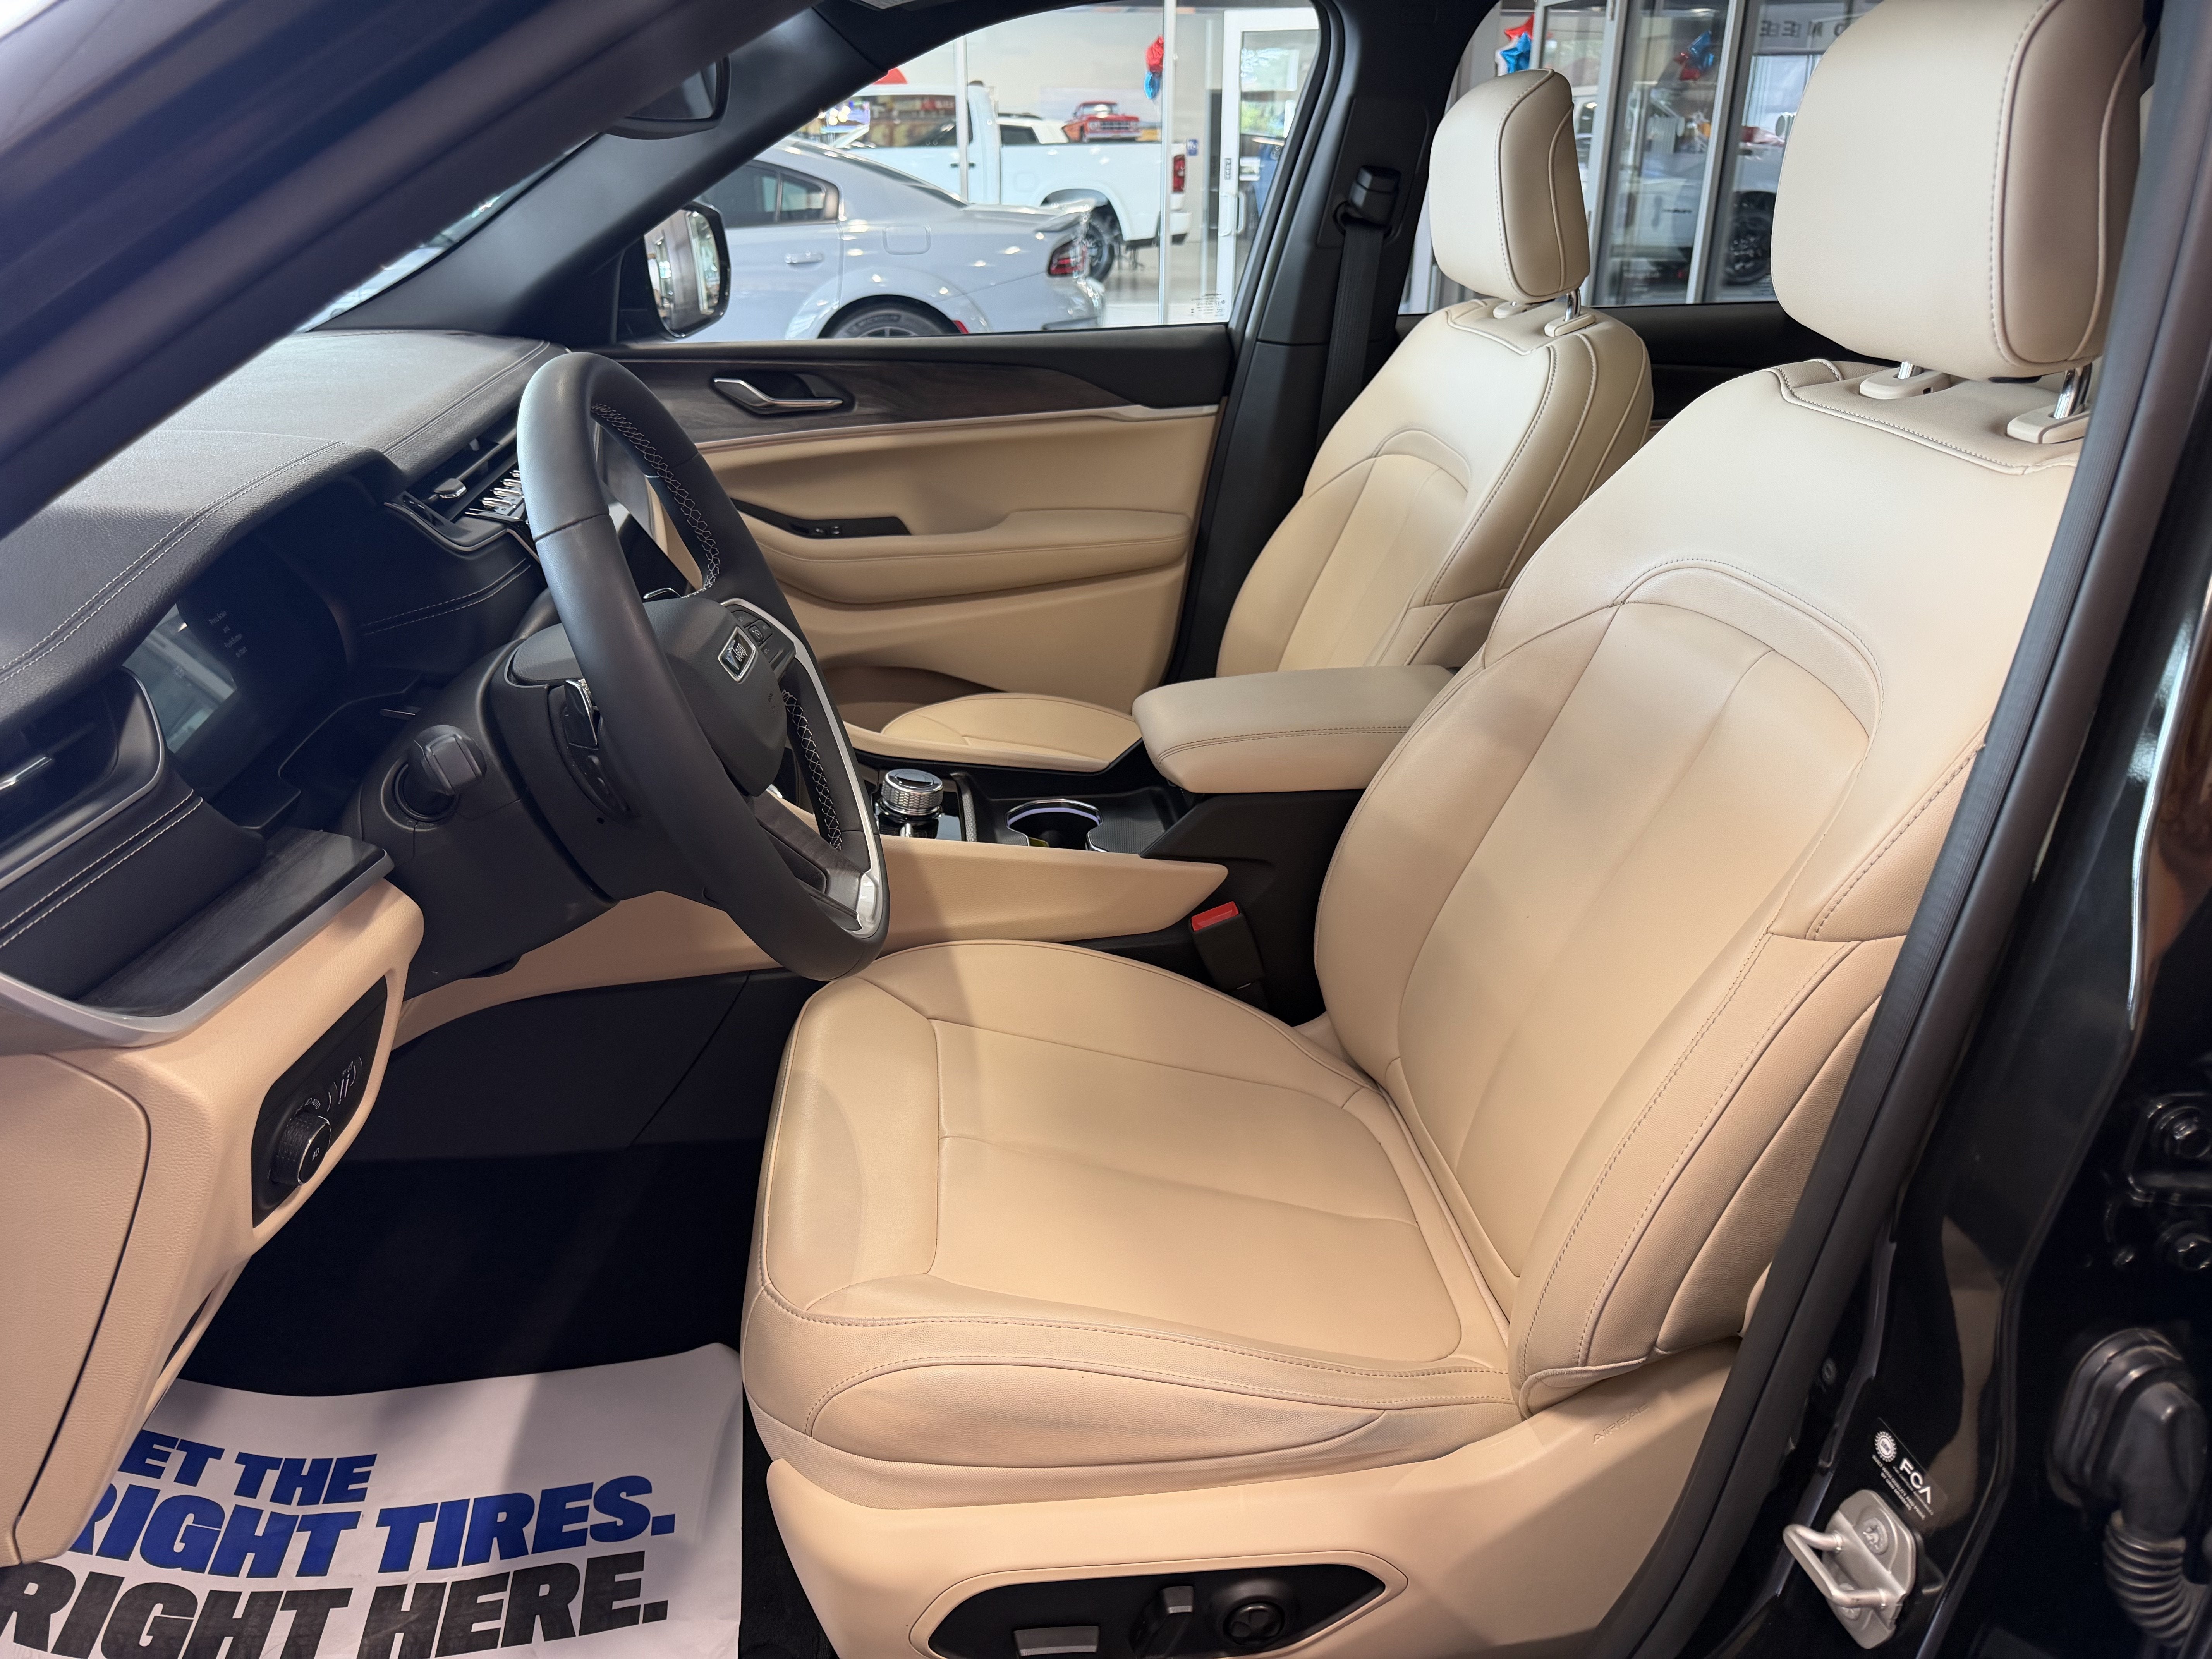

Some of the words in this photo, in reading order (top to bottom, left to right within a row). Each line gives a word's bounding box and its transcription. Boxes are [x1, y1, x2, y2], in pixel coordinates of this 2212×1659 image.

[732, 643, 748, 662] Jeep
[311, 1098, 321, 1109] AUTO
[117, 1429, 225, 1487] ET
[234, 1454, 378, 1506] THE
[1899, 1458, 1931, 1504] FCA
[375, 1475, 675, 1574] TIRES.
[0, 1561, 354, 1659] RIGHT
[356, 1550, 668, 1659] HERE.
